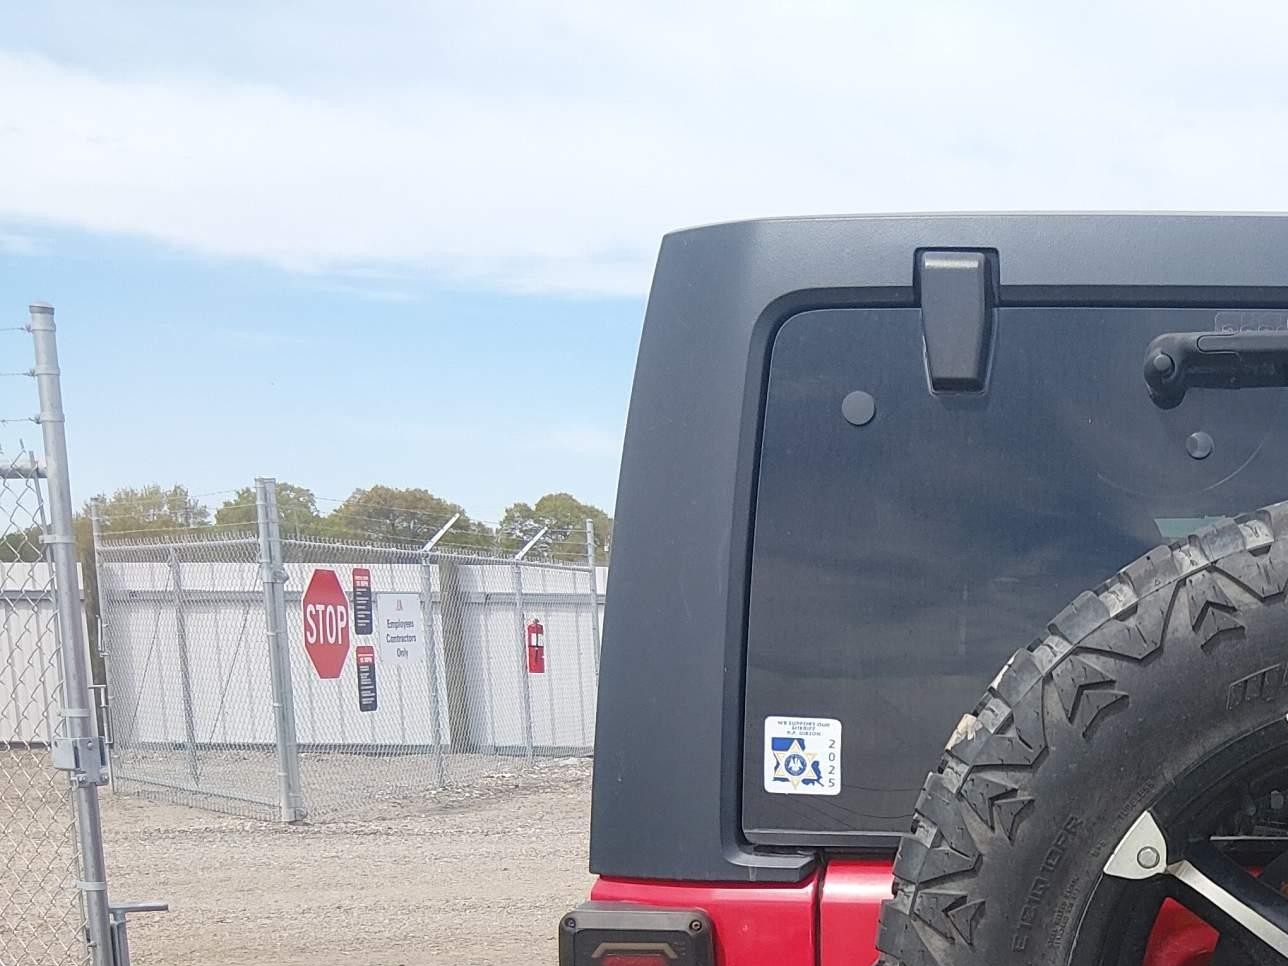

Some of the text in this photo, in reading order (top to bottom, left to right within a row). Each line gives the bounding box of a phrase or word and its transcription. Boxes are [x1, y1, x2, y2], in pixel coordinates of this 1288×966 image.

[306, 604, 347, 644] STOP
[386, 633, 416, 643] Contractors
[397, 647, 409, 659] Only
[828, 739, 836, 788] 2025
